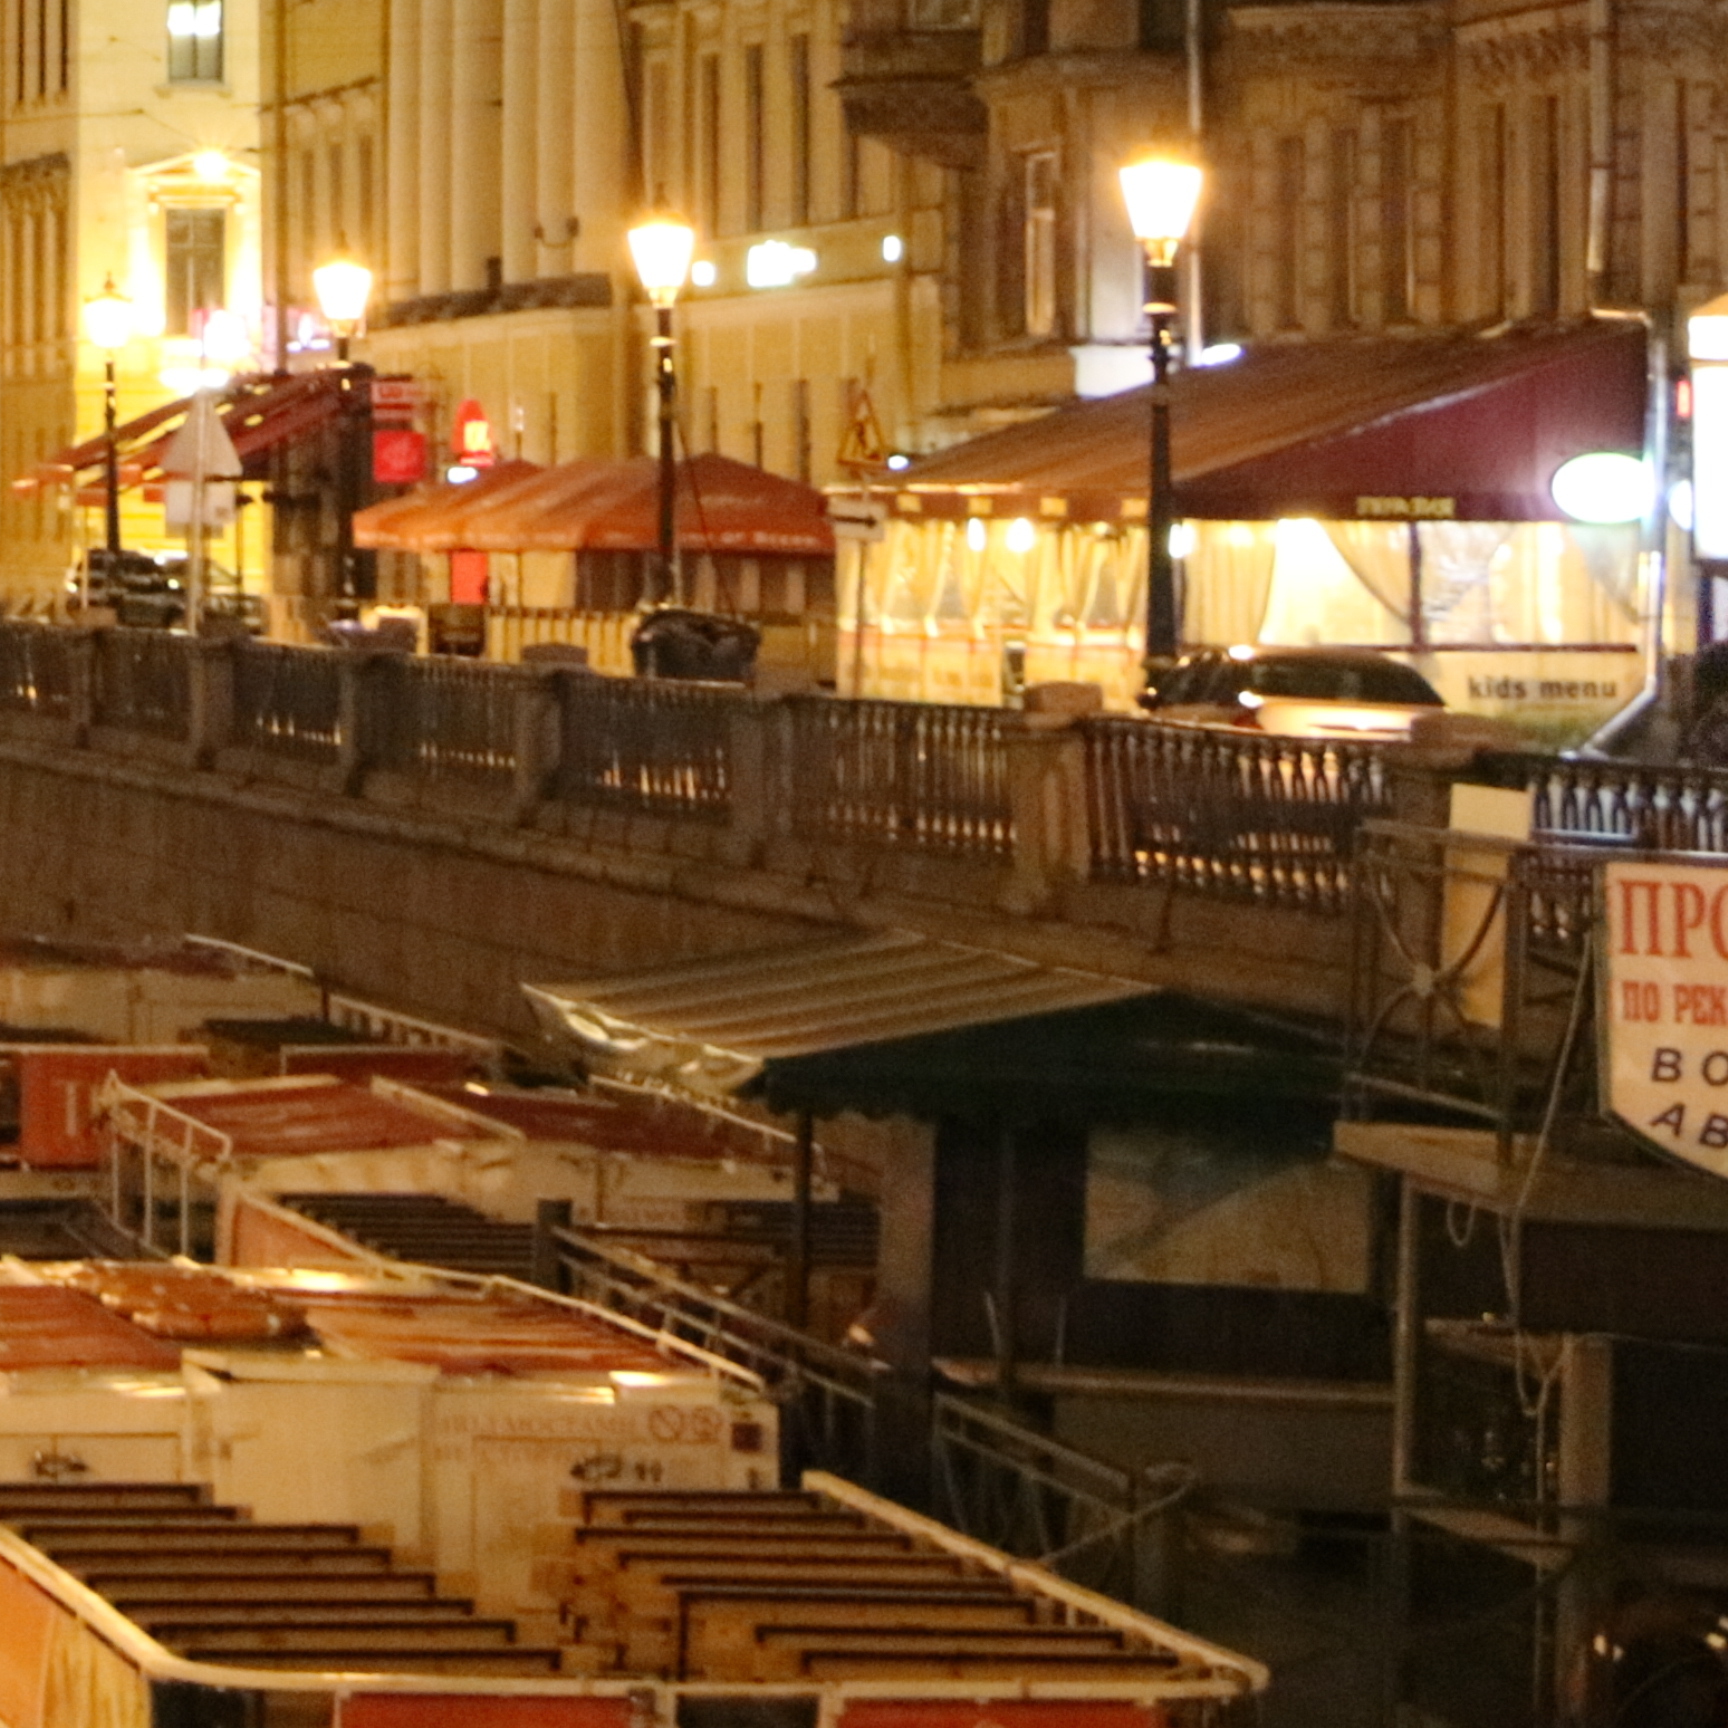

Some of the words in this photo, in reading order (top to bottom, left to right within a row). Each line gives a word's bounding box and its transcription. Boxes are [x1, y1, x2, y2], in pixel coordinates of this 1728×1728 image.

[1468, 676, 1527, 699] kids
[1539, 680, 1617, 699] menu
[1621, 979, 1660, 1023] ПО
